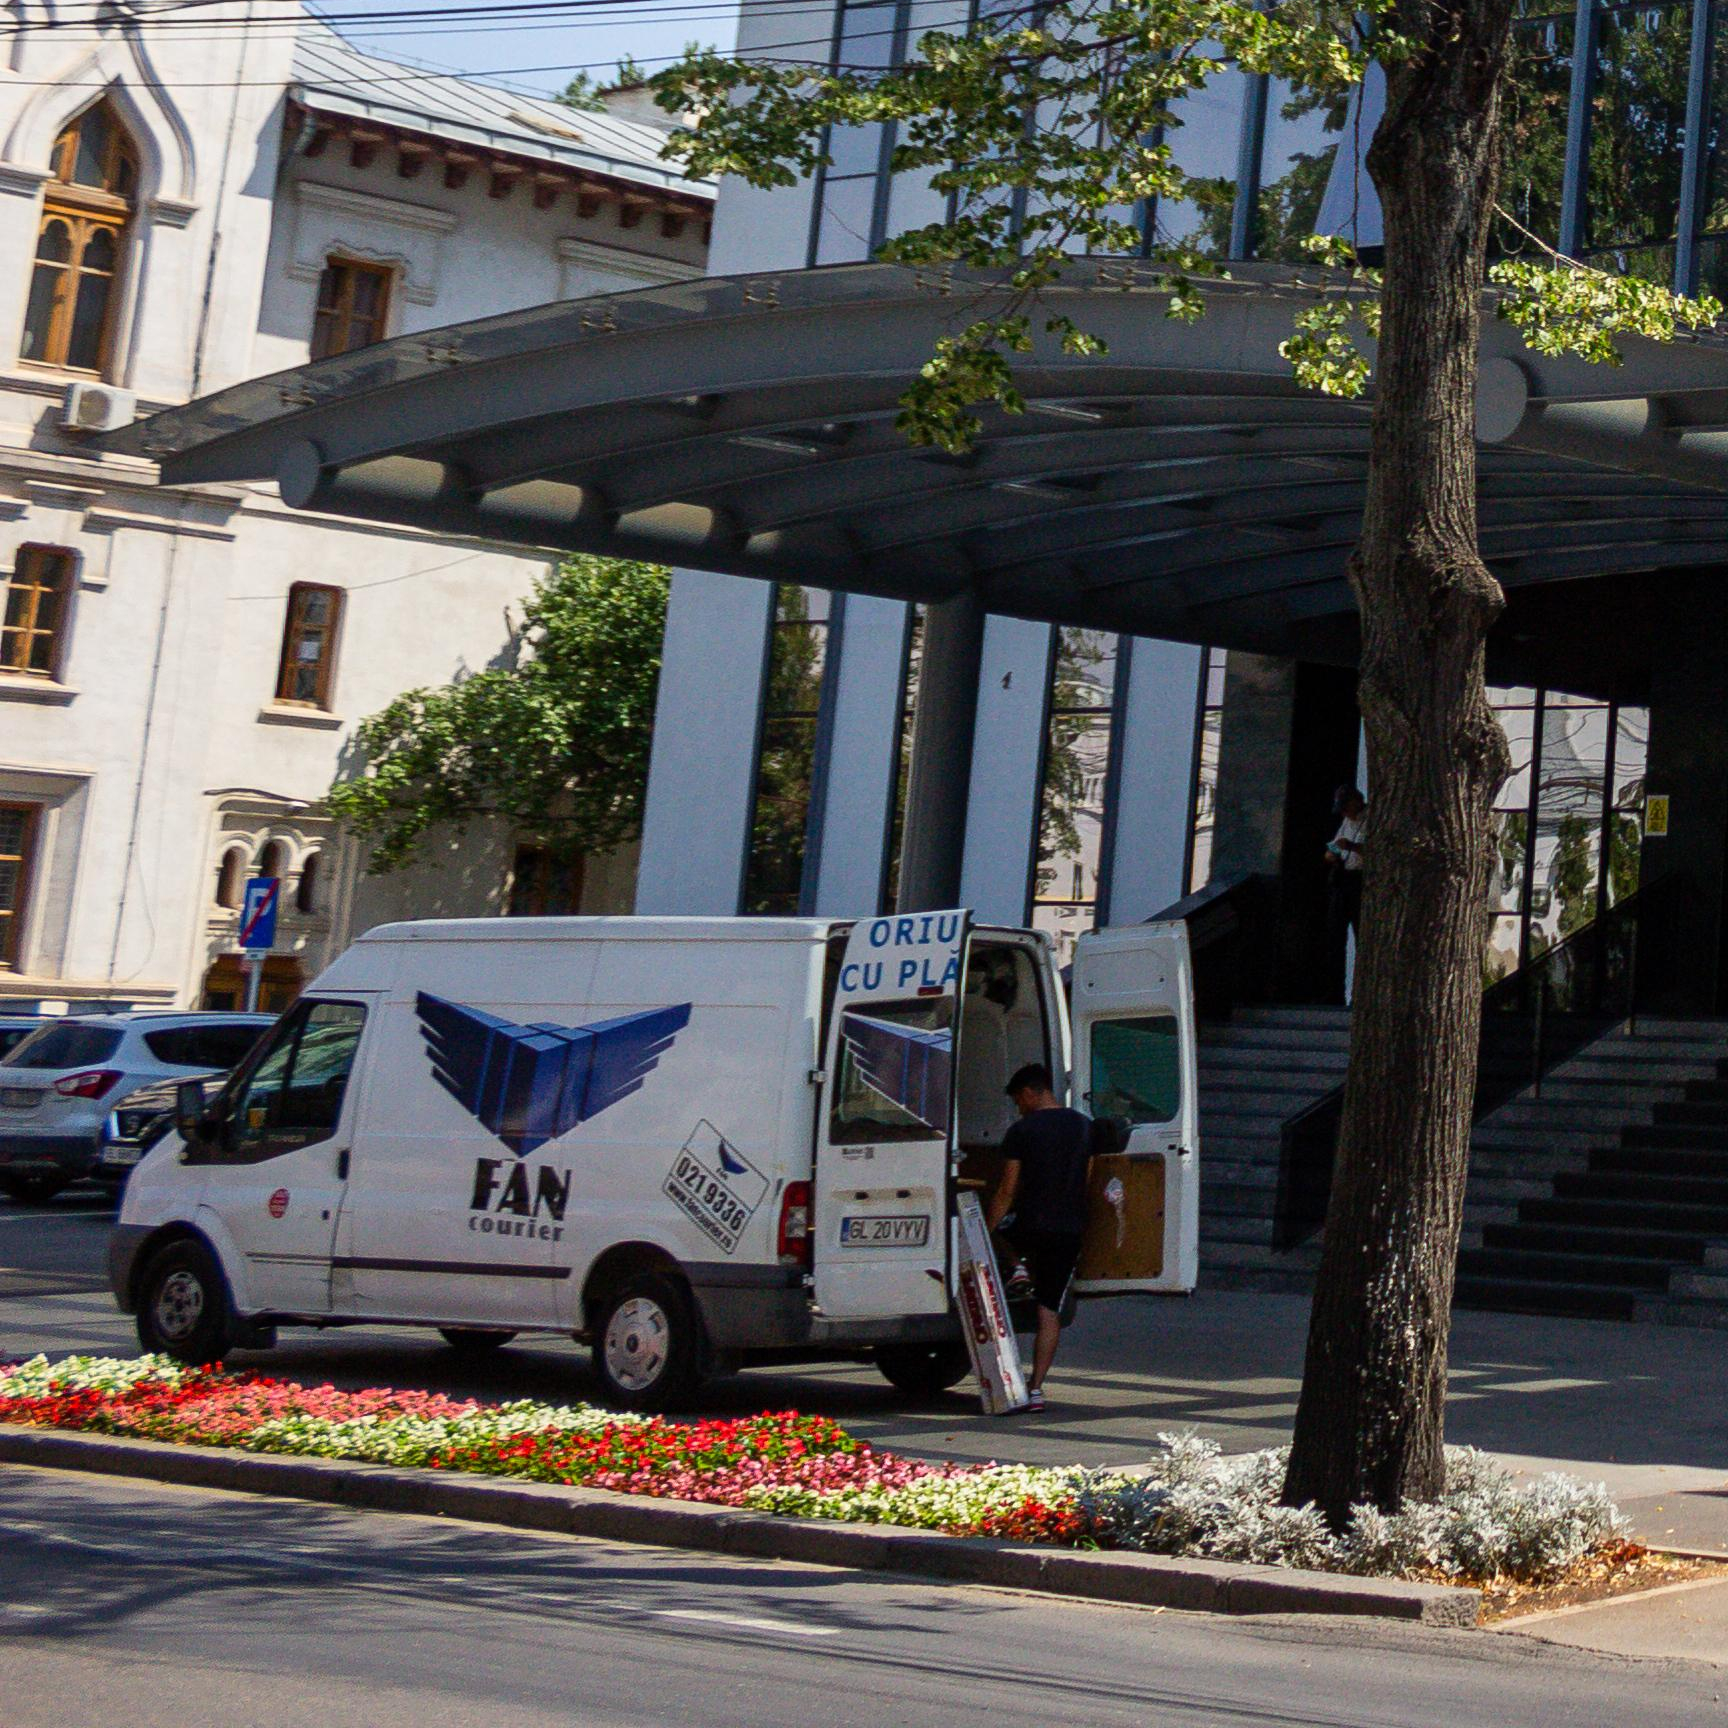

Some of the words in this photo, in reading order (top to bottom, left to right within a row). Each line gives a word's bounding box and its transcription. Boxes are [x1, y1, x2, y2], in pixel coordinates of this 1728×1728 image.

[869, 915, 958, 947] ORIU
[841, 962, 882, 992] CU
[470, 1157, 572, 1221] FAN
[677, 1157, 707, 1193] 021
[703, 1182, 746, 1231] 9336
[468, 1215, 565, 1242] courier
[850, 1220, 867, 1239] GL
[873, 1220, 891, 1239] 20
[894, 1219, 924, 1240] VYV
